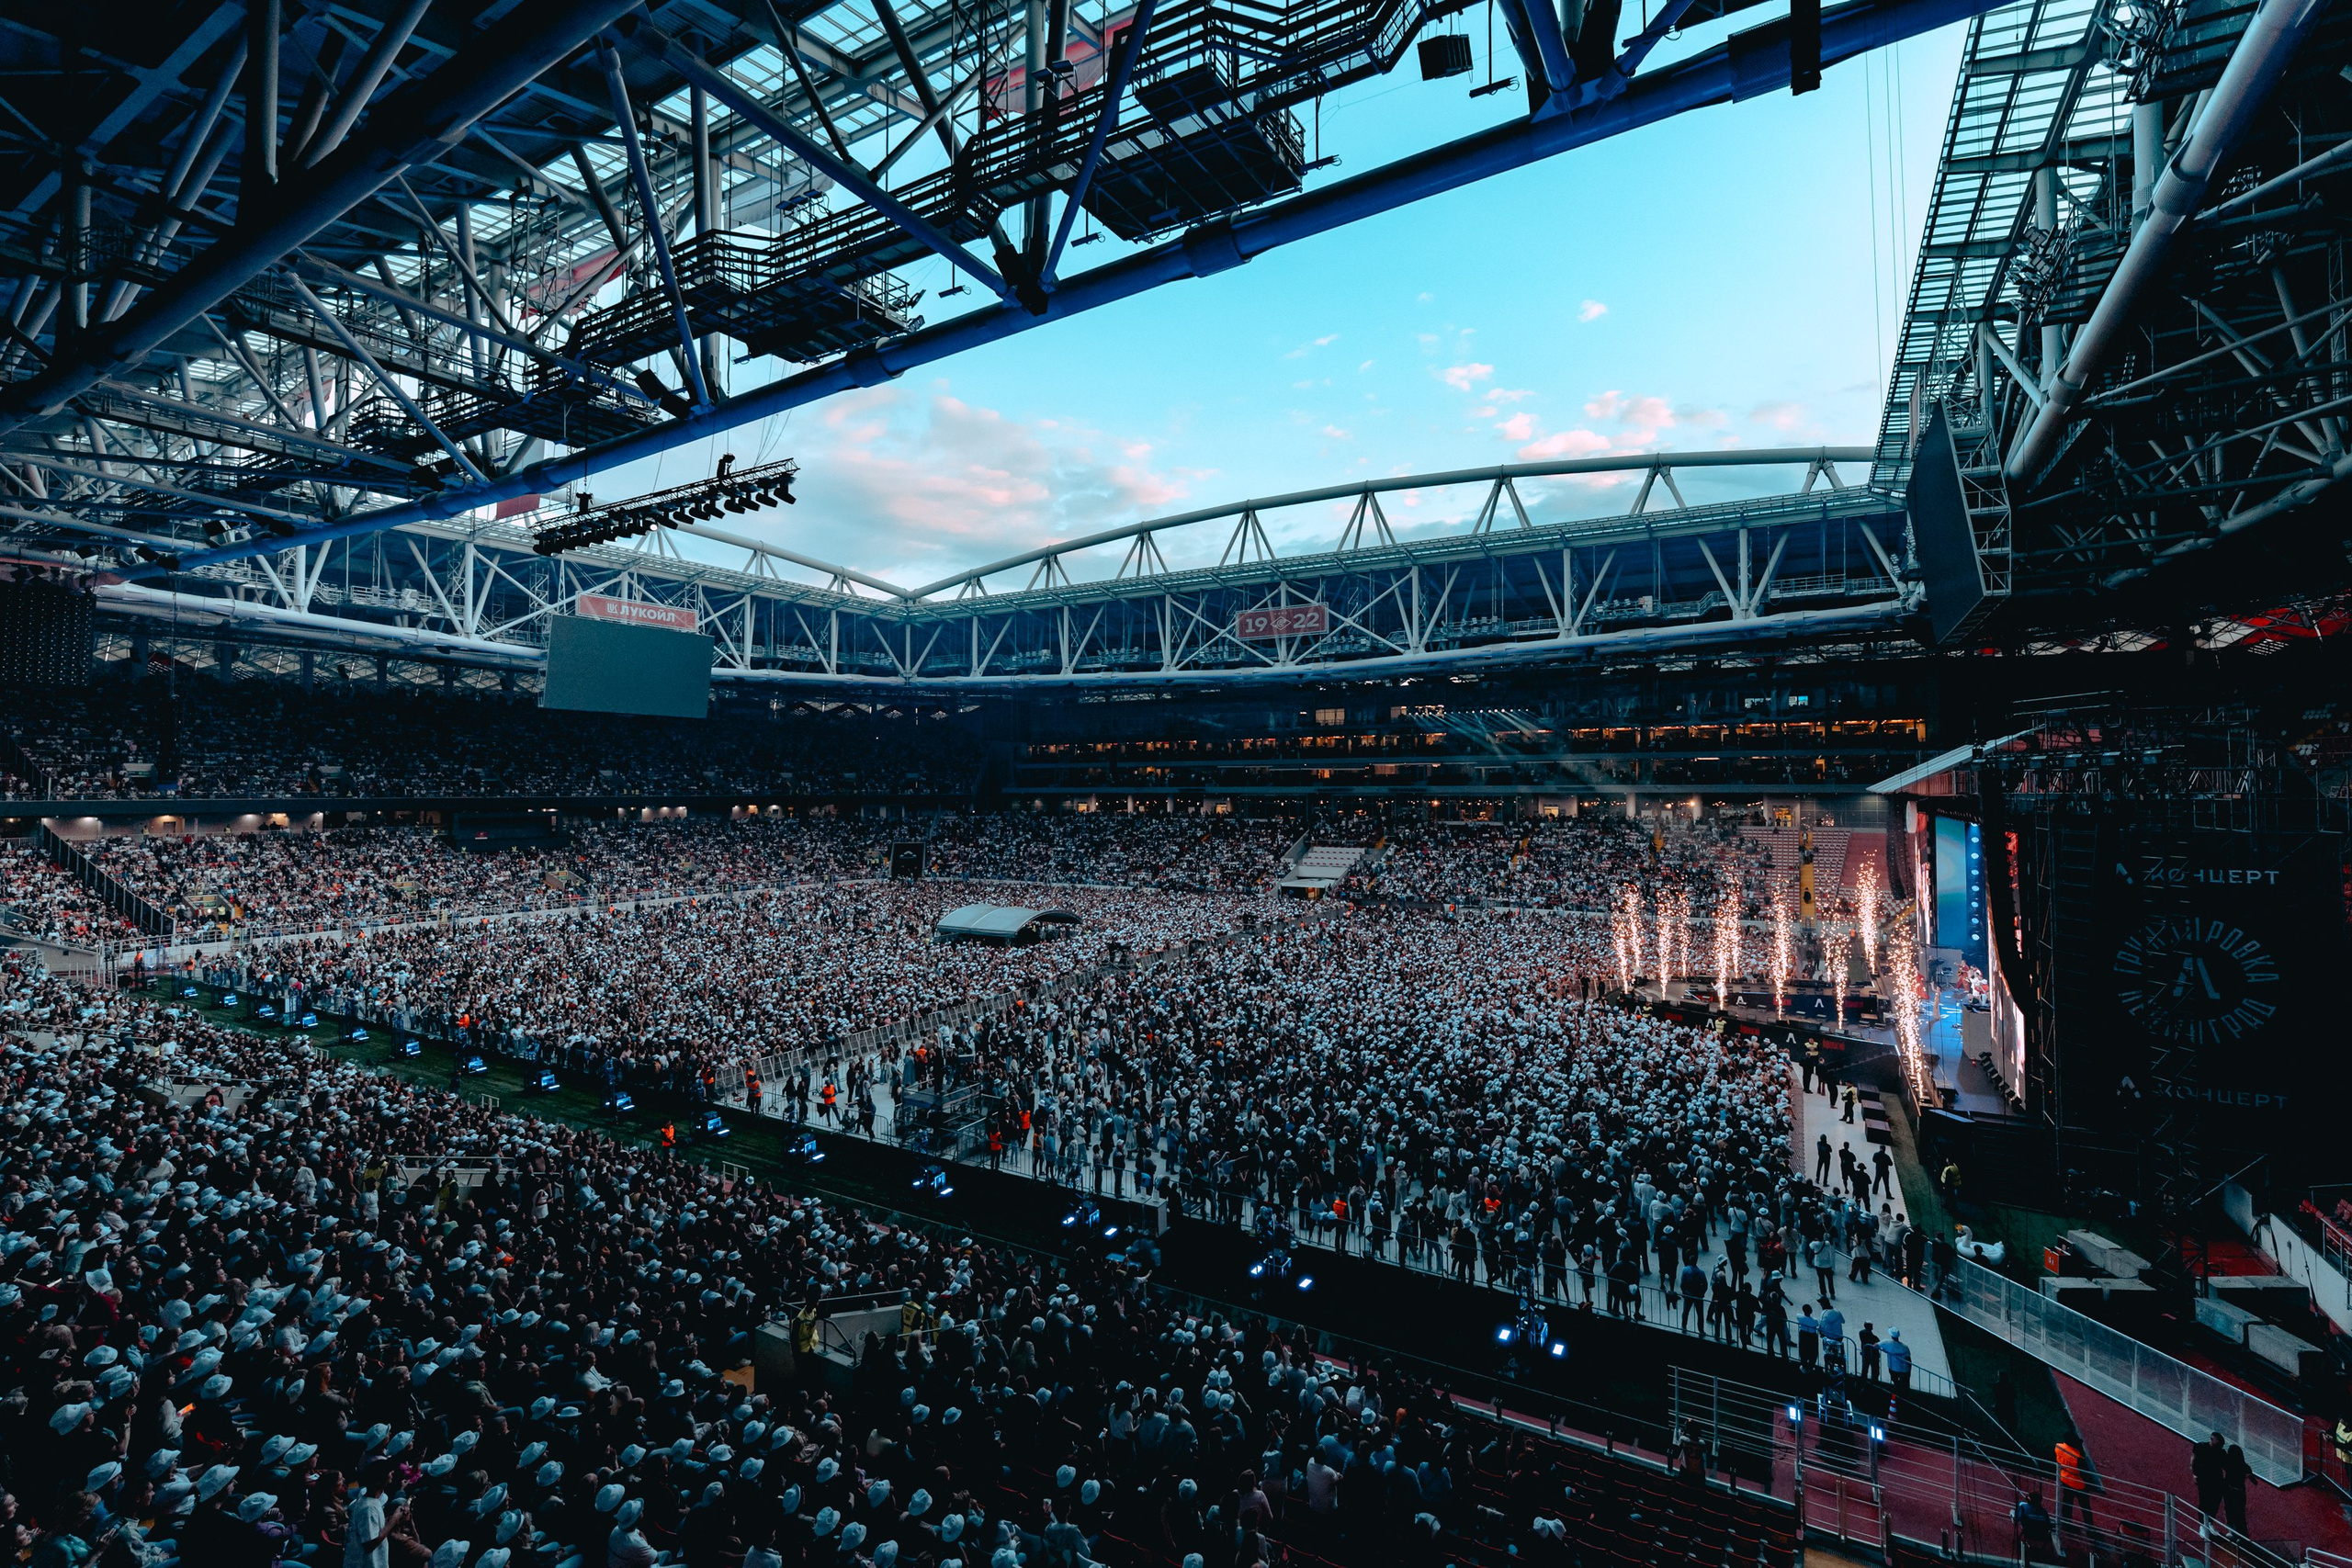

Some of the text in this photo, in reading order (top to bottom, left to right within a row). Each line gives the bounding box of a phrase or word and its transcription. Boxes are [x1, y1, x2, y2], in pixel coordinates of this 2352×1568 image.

[619, 604, 675, 623] ЛУКОЙЛ
[1245, 612, 1319, 633] 19 22
